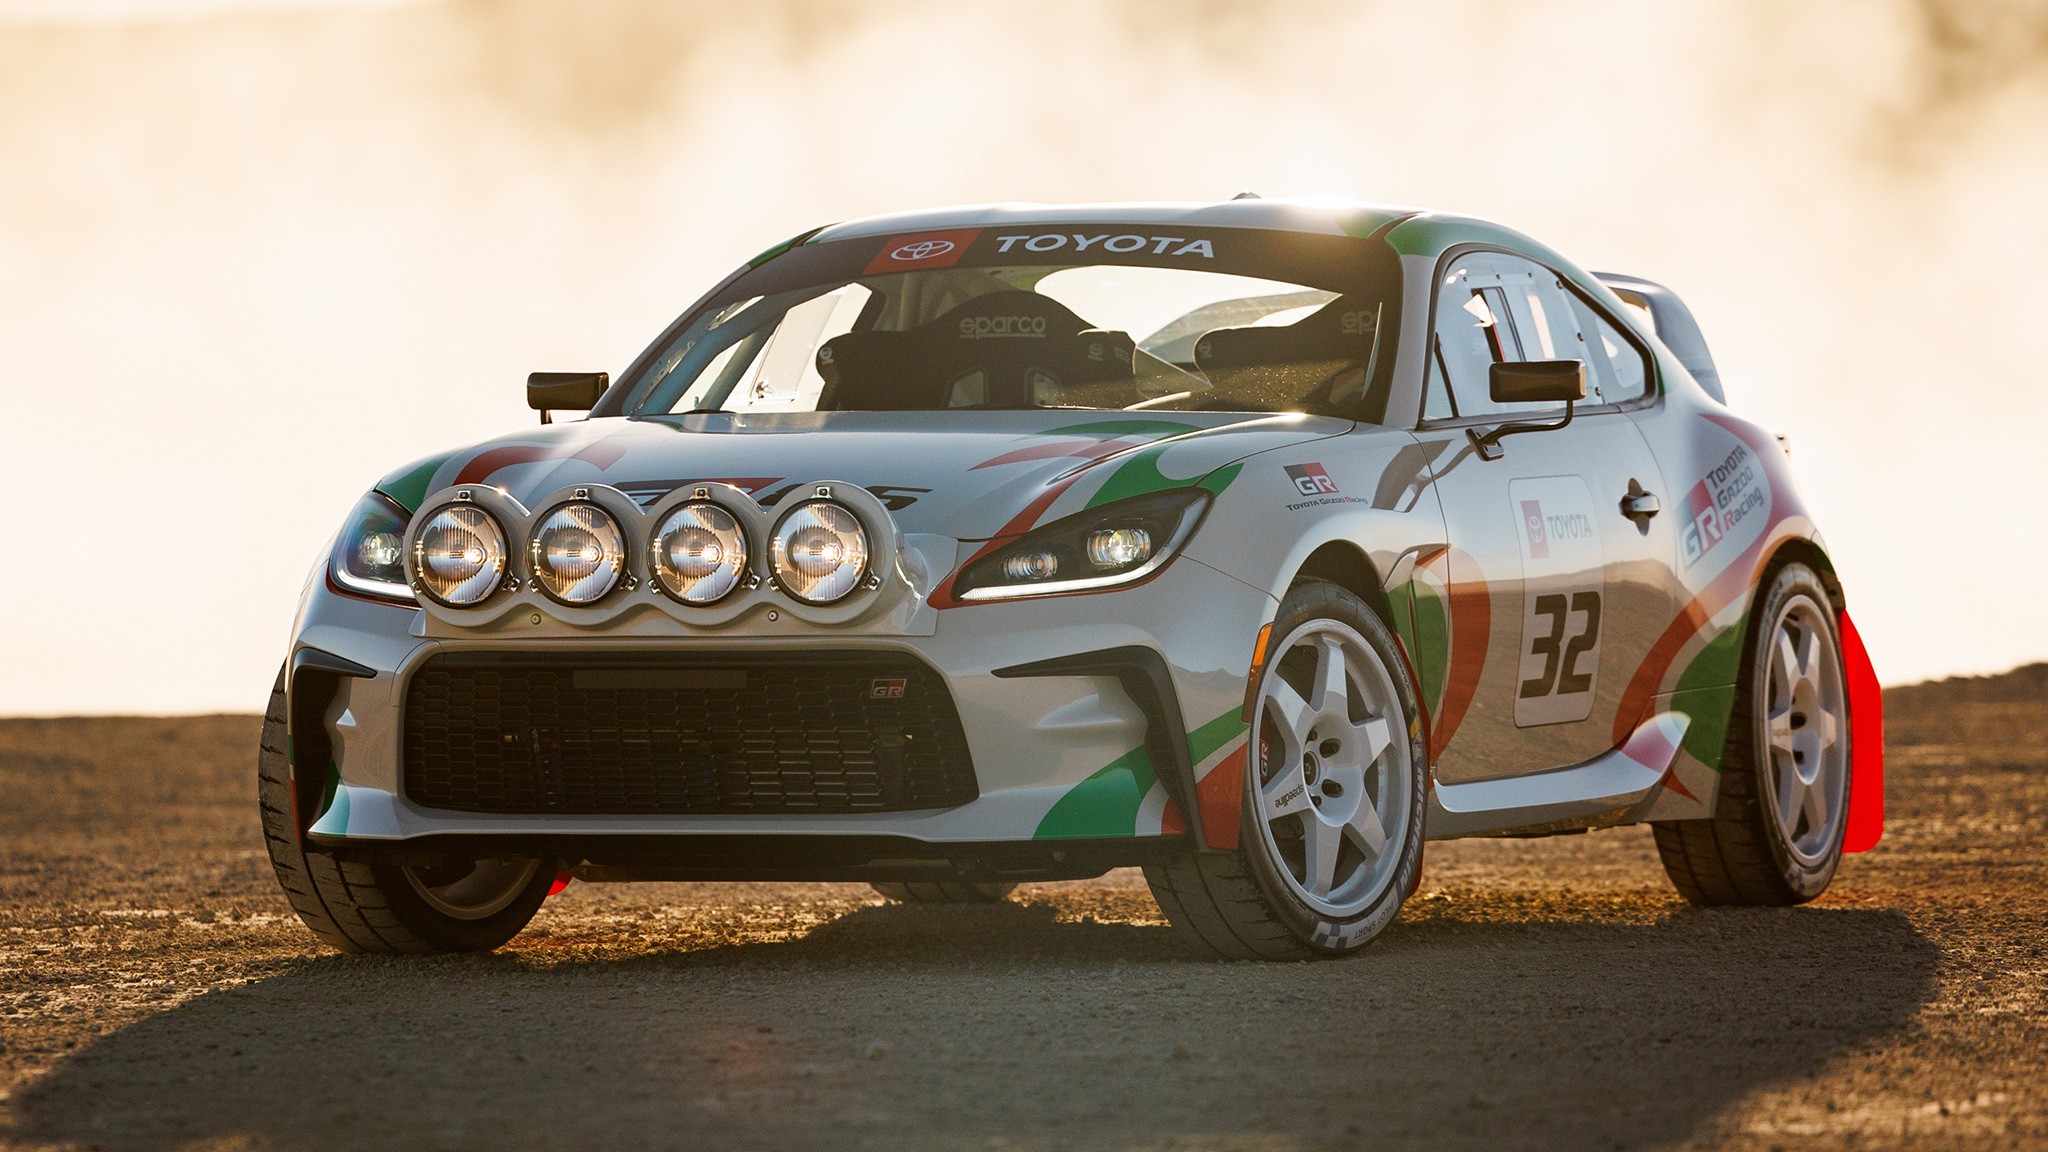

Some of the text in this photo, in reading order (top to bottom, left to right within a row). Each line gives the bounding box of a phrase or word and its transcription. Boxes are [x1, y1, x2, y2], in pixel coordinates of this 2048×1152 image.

[996, 234, 1214, 258] TOYOTA
[959, 316, 1046, 339] sparco
[1706, 445, 1746, 489] TOYOTA
[1295, 475, 1337, 494] GR
[1717, 466, 1753, 509] GAZOO
[1286, 501, 1319, 511] TOYOTA
[1723, 487, 1764, 531] Racing
[1547, 514, 1592, 540] TOYOTA
[1681, 506, 1721, 558] GR
[1519, 590, 1600, 698] 32
[873, 687, 903, 696] GR
[1399, 766, 1424, 891] MICHELIN
[1353, 921, 1377, 939] SPORT
